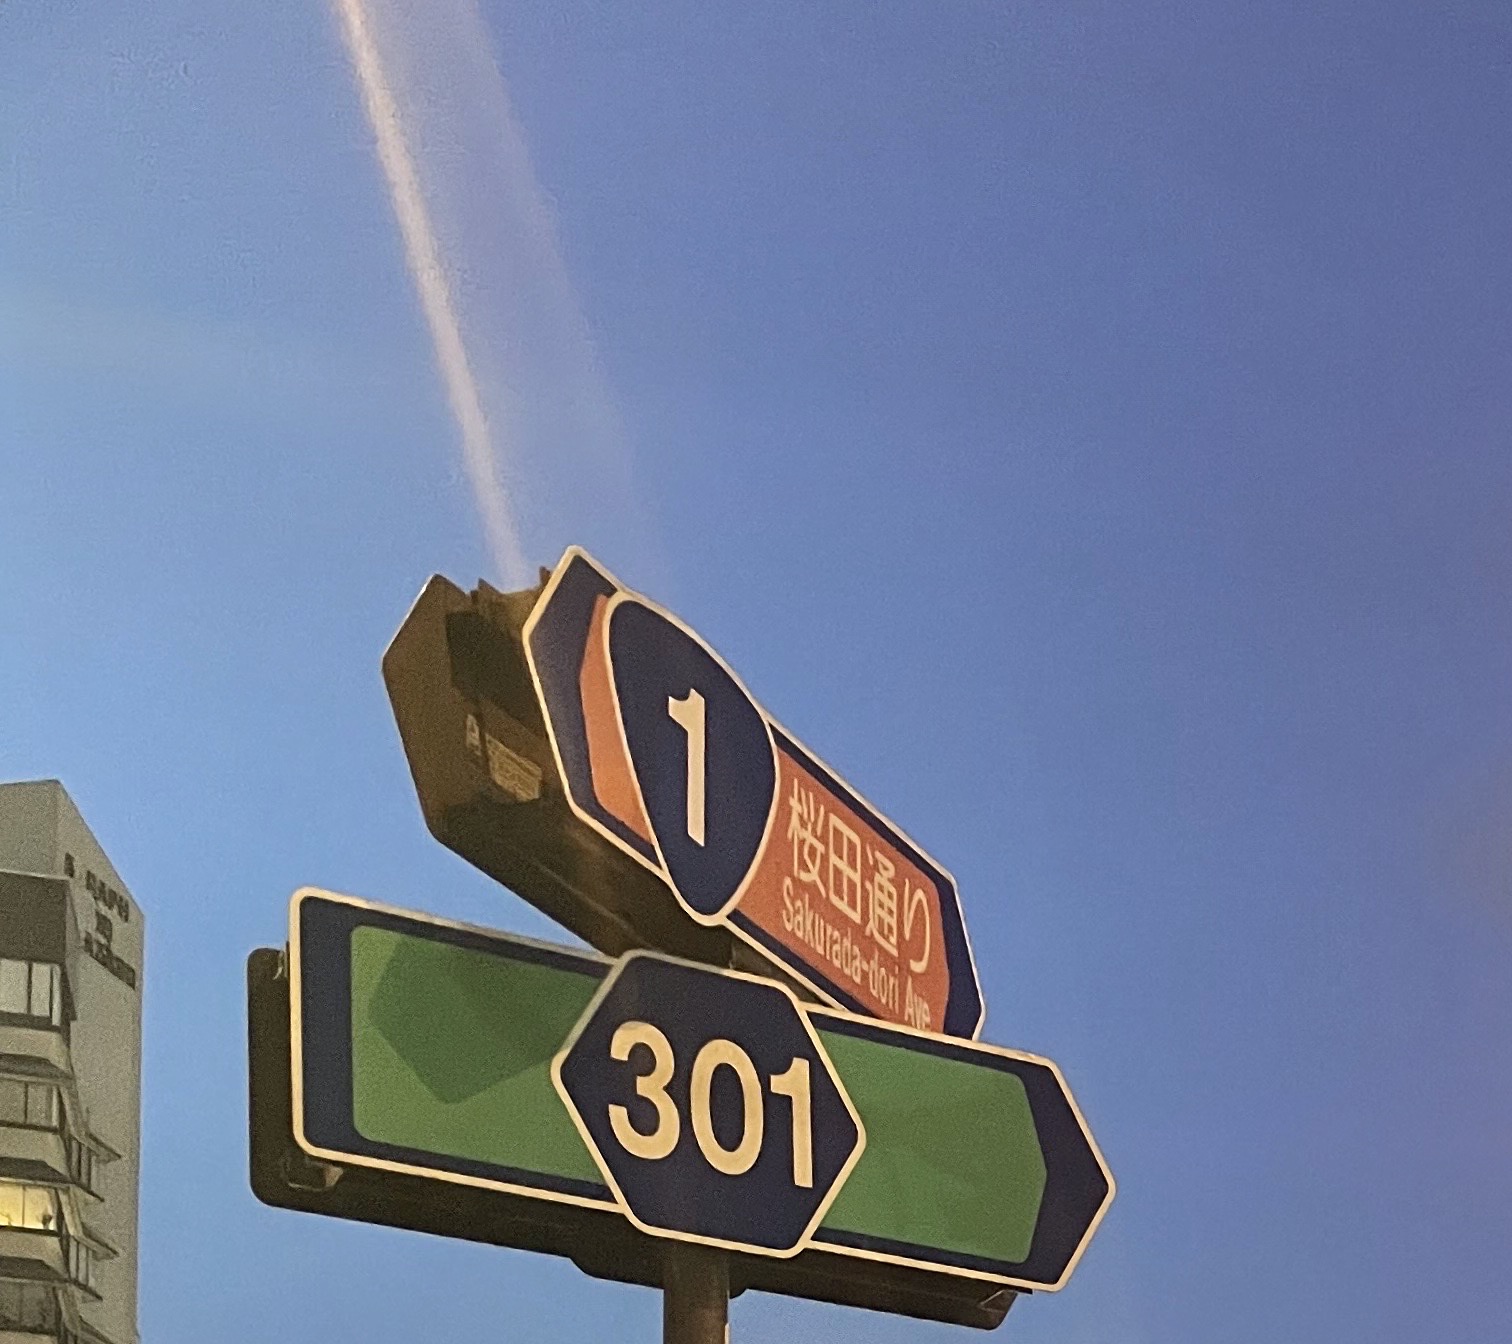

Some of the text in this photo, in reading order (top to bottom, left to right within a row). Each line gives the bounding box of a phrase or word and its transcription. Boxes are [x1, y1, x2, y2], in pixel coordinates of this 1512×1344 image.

[666, 687, 706, 848] 1
[782, 875, 899, 1014] Sakurada-dori
[786, 777, 932, 974] 桜田通り
[607, 1020, 815, 1188] 301
